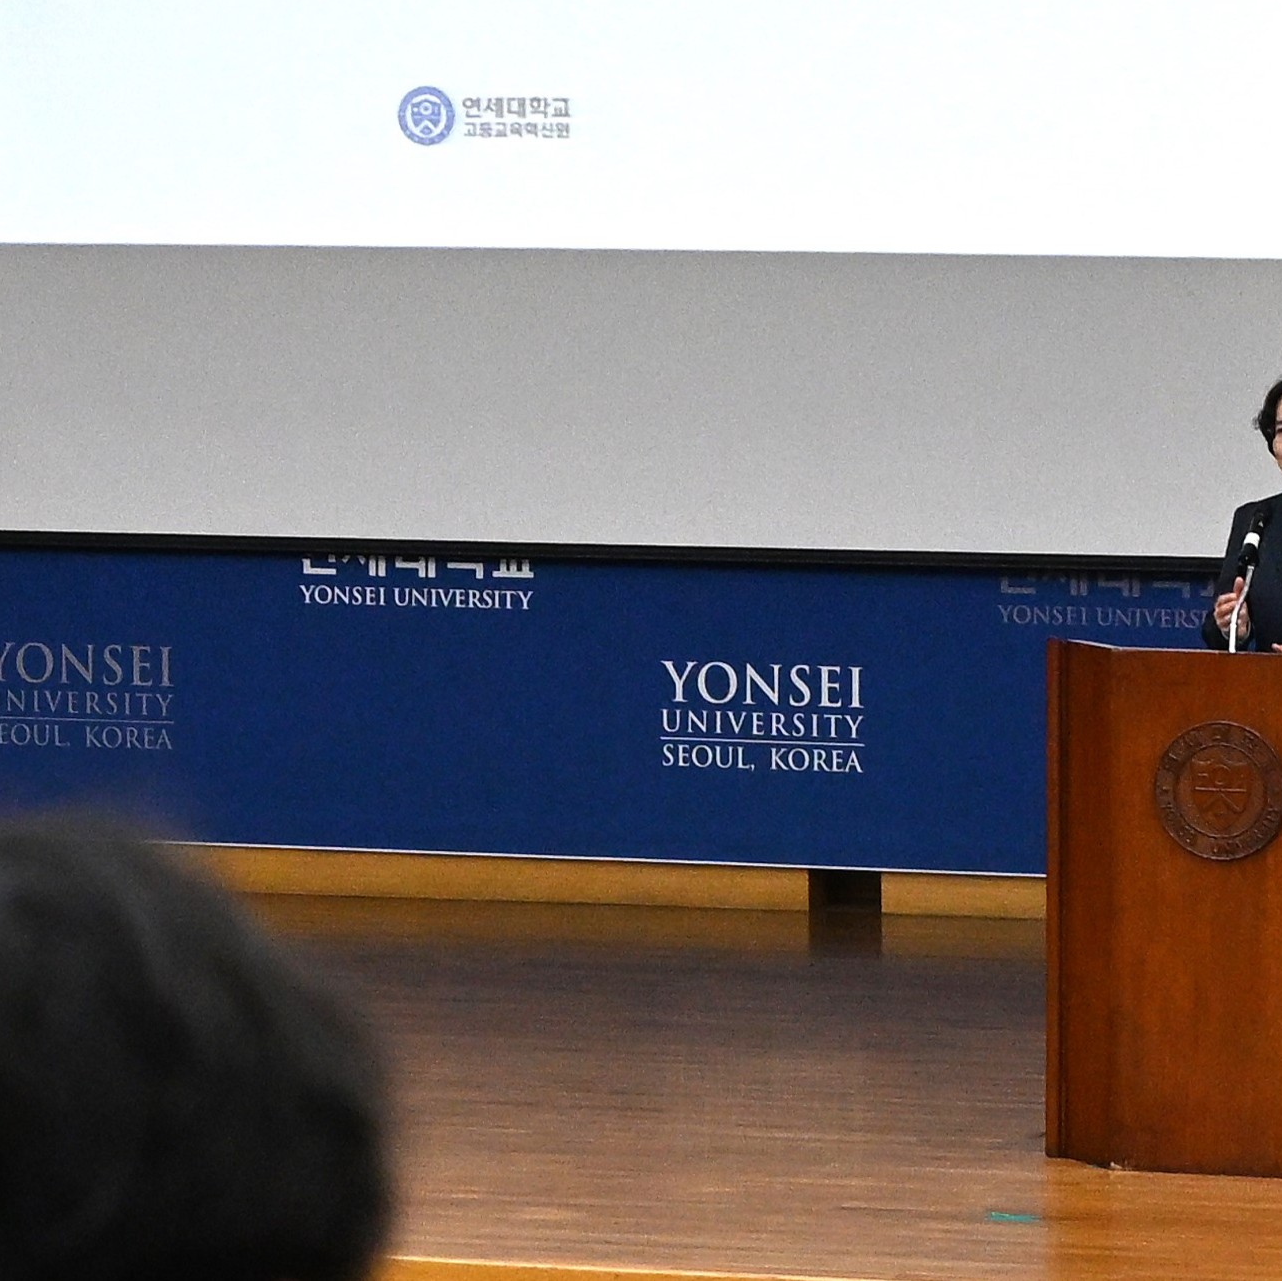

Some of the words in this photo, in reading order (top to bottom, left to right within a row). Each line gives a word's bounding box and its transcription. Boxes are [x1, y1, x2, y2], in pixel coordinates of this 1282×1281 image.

[461, 96, 572, 120] 연세대학교
[299, 584, 386, 606] YONSEI
[393, 587, 534, 610] UNIVERSITY
[997, 604, 1088, 626] YONSEI
[661, 660, 864, 709] YONSEI
[661, 708, 864, 739] UNIVERSITY
[85, 725, 173, 750] KOREA
[662, 743, 755, 772] SEOUL,
[770, 747, 864, 774] KOREA
